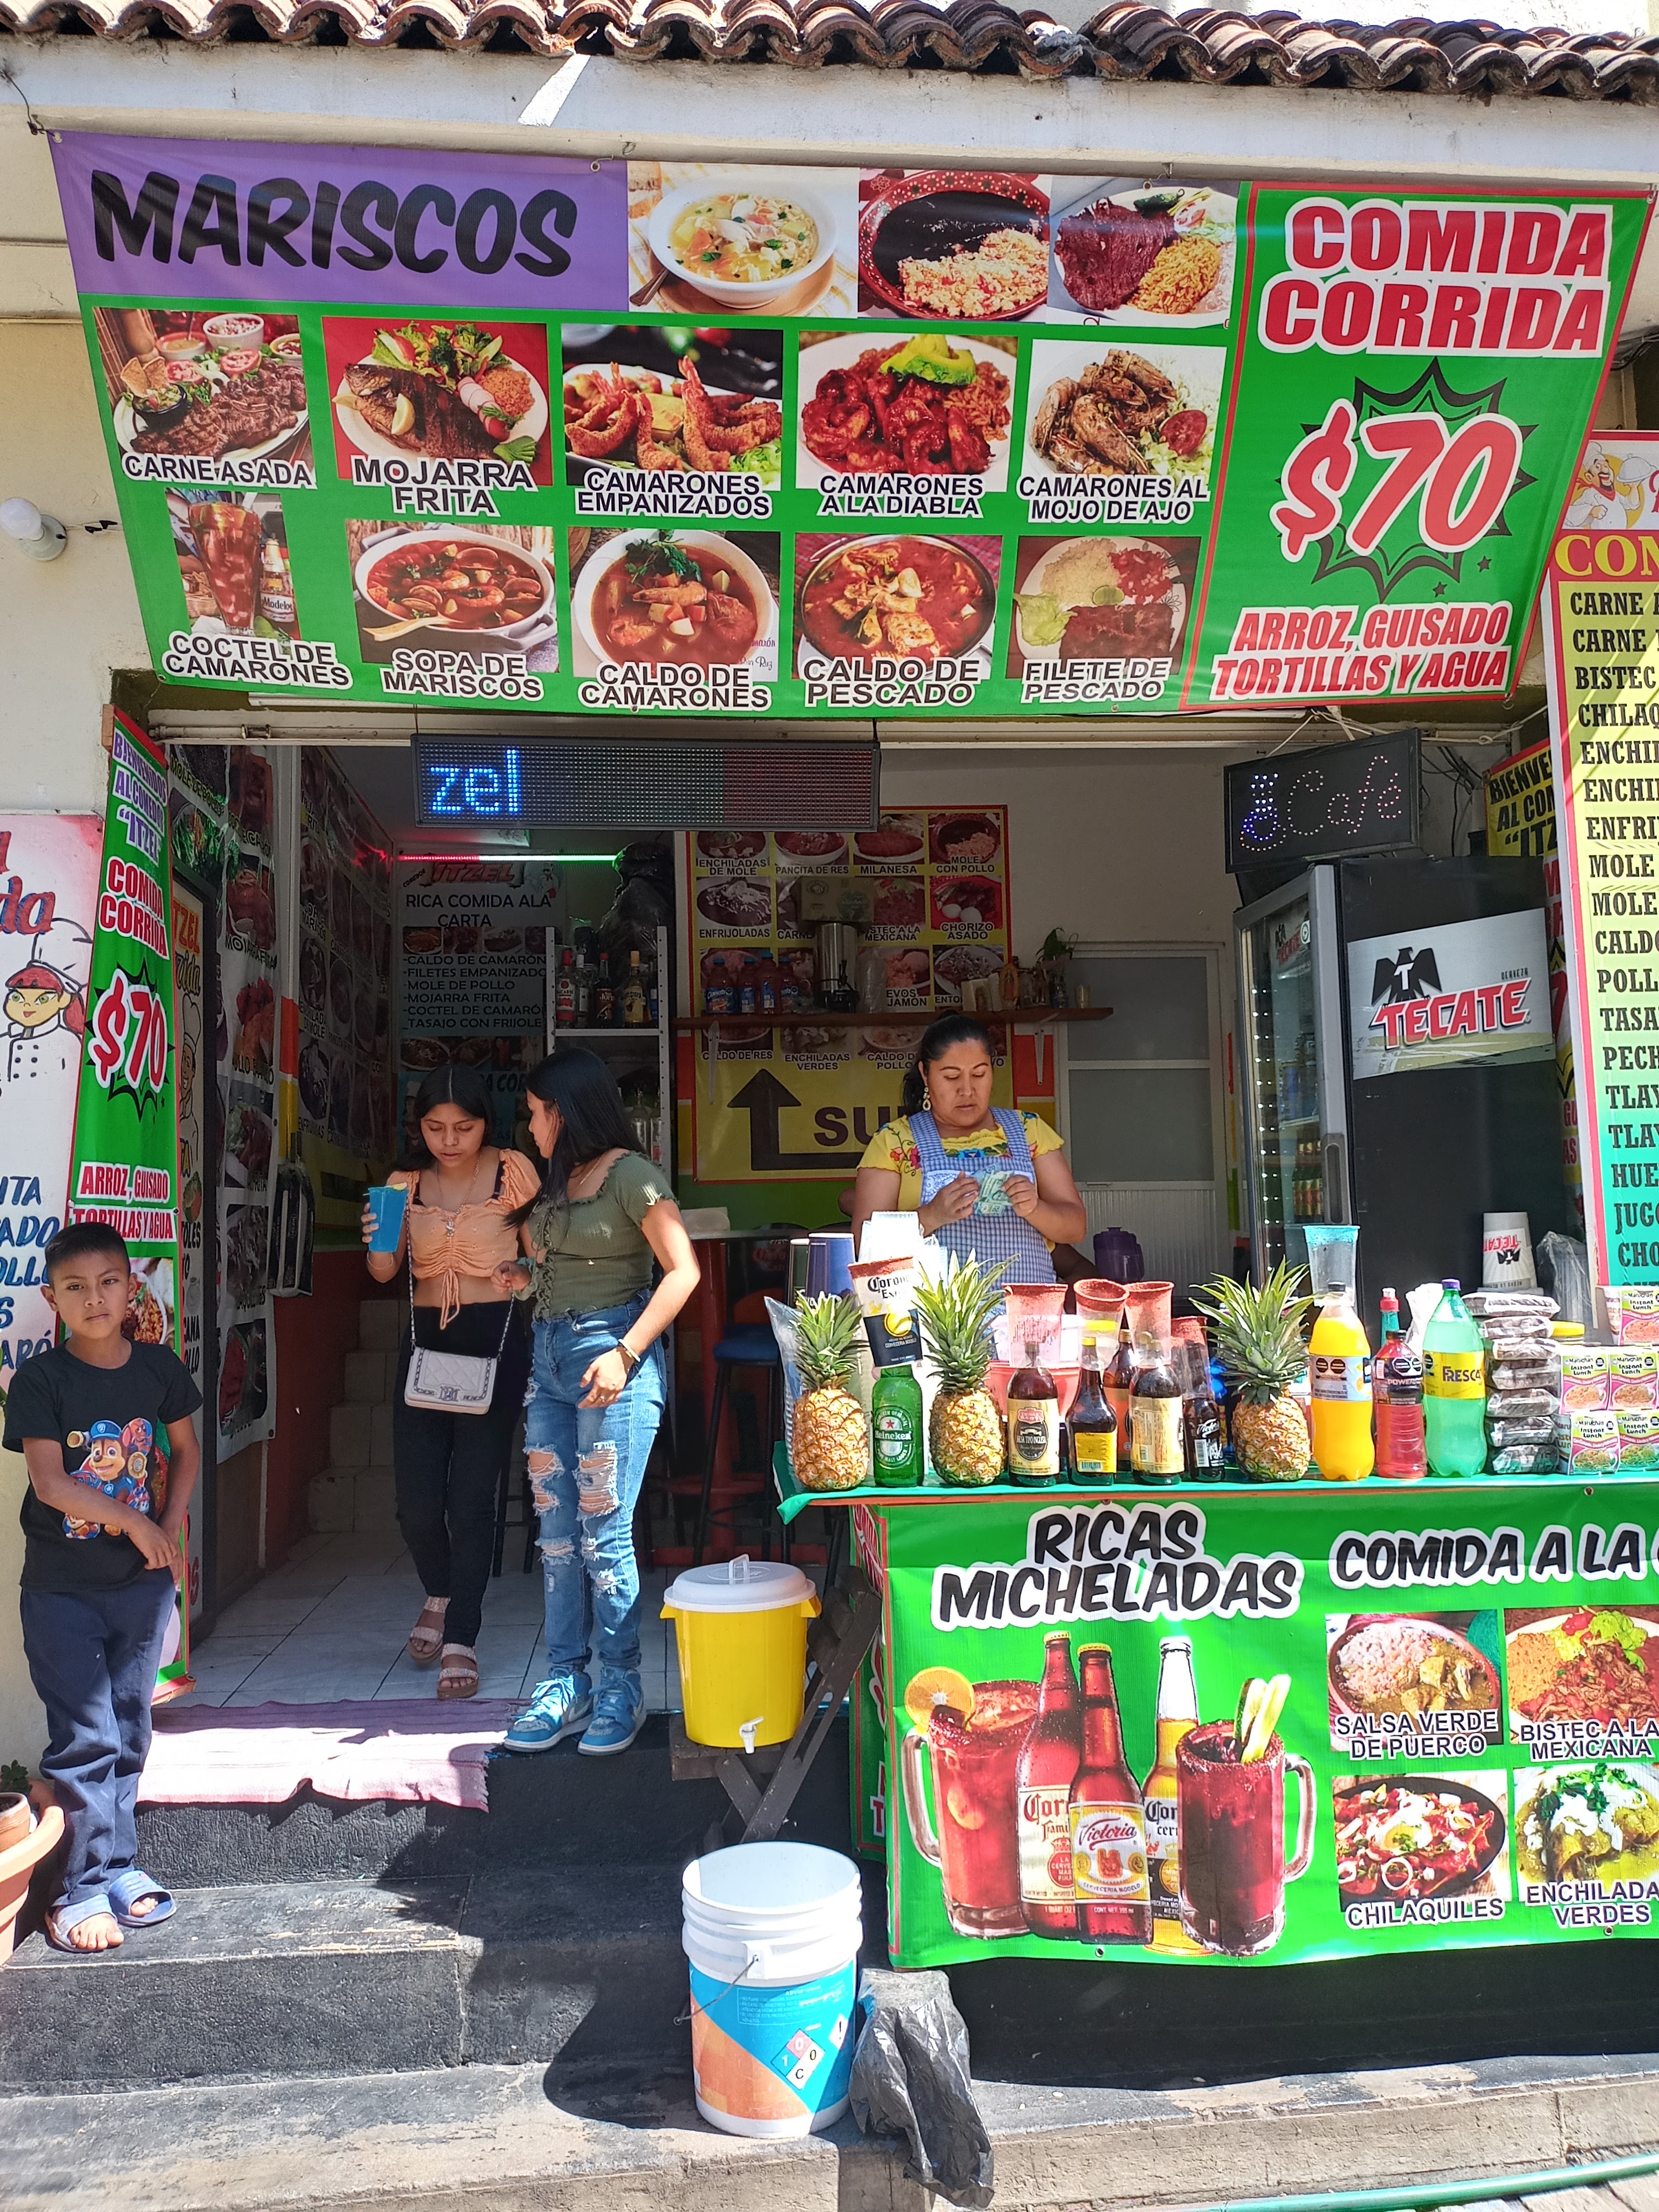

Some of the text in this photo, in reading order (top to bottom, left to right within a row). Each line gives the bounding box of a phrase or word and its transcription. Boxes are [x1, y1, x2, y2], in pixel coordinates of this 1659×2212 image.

[91, 170, 578, 277] MARISCOS
[1292, 206, 1607, 276] COMIDA
[1265, 278, 1603, 351] CORRIDA
[125, 456, 313, 486] CARNE ASADA
[356, 458, 533, 488] MOJARRA
[1275, 405, 1522, 555] $70
[587, 472, 759, 494] CAMARONES
[820, 476, 983, 496] CAMARONES
[1020, 477, 1207, 497] CAMARONES AL
[395, 487, 495, 514] FRITA
[578, 492, 769, 515] EMPANIZADOS
[822, 497, 979, 515] A LA DIABLA
[1031, 501, 1191, 520] MOJO DE AJO
[1571, 592, 1644, 615] CARNE
[1234, 607, 1509, 651] ARROZ, GUISADO
[173, 635, 335, 664] COCTEL DE
[1573, 629, 1646, 653] CARNE
[165, 655, 350, 686] CAMARONES
[395, 652, 525, 676] SOPA DE
[804, 660, 979, 682] CALDO DE
[1025, 661, 1170, 681] FILETE DE
[1216, 651, 1510, 696] TORTILLAS Y AGUA
[383, 671, 541, 698] MARISCOS
[600, 665, 750, 687] CALDO DE
[1574, 666, 1656, 690] BISTEC
[581, 686, 768, 708] CAMARONES
[807, 682, 974, 705] PESCADO
[1024, 681, 1162, 701] PESCADO
[113, 733, 167, 804] BIENVENIDOS
[431, 748, 520, 813] zel
[114, 770, 164, 832] AL COMEDOR
[1497, 805, 1520, 832] AL
[1585, 816, 1659, 846] ENFRI
[433, 863, 515, 881] ITZEL
[699, 859, 766, 868] ENCHILADAS
[775, 866, 813, 874] PANCITA
[831, 865, 849, 874] RES
[860, 865, 917, 874] MILANESA
[936, 864, 995, 873] CON POLLO
[1589, 854, 1655, 878] MOLE
[108, 859, 164, 919] COMIDA
[403, 868, 426, 888] COMEDOR
[406, 894, 551, 907] RICA COMIDA ALA
[1592, 891, 1657, 916] MOLE
[100, 895, 168, 958] CORRIDA
[438, 914, 492, 927] CARTA
[941, 923, 994, 931] CHORIZO
[699, 928, 770, 938] ENFRIJOLADAS
[947, 931, 988, 940] ASADO
[458, 956, 474, 964] DE
[478, 952, 546, 964] CAMARÓN
[450, 981, 466, 990] DE
[470, 980, 515, 990] POLLO
[1598, 968, 1659, 992] POLL
[474, 993, 510, 1003] FRITA
[887, 998, 927, 1006] JAMON
[462, 1005, 479, 1015] DE
[1369, 977, 1532, 1050] TECATE
[1600, 1007, 1659, 1031] TASA
[93, 974, 166, 1091] $70
[460, 1018, 489, 1028] CON
[493, 1018, 542, 1029] FRIJOLE
[738, 1050, 773, 1060] DE RES
[785, 1053, 851, 1062] ENCHILADAS
[797, 1061, 838, 1070] VERDES
[867, 1052, 904, 1061] CALDO
[80, 1166, 168, 1201] ARROZ, GUISADO
[1611, 1164, 1659, 1188] HUE
[73, 1209, 173, 1239] TORTILLAS Y AGUA
[1614, 1202, 1659, 1235] JUG
[1442, 1366, 1482, 1382] FRESCA
[875, 1429, 912, 1441] Heineken
[1034, 1510, 1199, 1565] RICAS
[1336, 1528, 1640, 1583] COMIDA A LA
[940, 1561, 1296, 1622] MICHELADAS
[1336, 1712, 1498, 1735] SALSA VERDE
[1520, 1720, 1659, 1742] BISTEC A LA
[1351, 1736, 1486, 1759] DE PUERCO
[1531, 1740, 1650, 1760] MEXICANA
[1078, 1817, 1137, 1850] Victoria
[1083, 1881, 1141, 1893] CERVECERIA MODELO
[1526, 1881, 1659, 1905] ENCHILADA
[1347, 1898, 1504, 1927] CHILAQUILES
[1554, 1903, 1650, 1927] VERDES
[794, 2037, 805, 2051] 0
[810, 2049, 817, 2060] 0
[781, 2054, 788, 2067] 1
[795, 2068, 804, 2079] C
